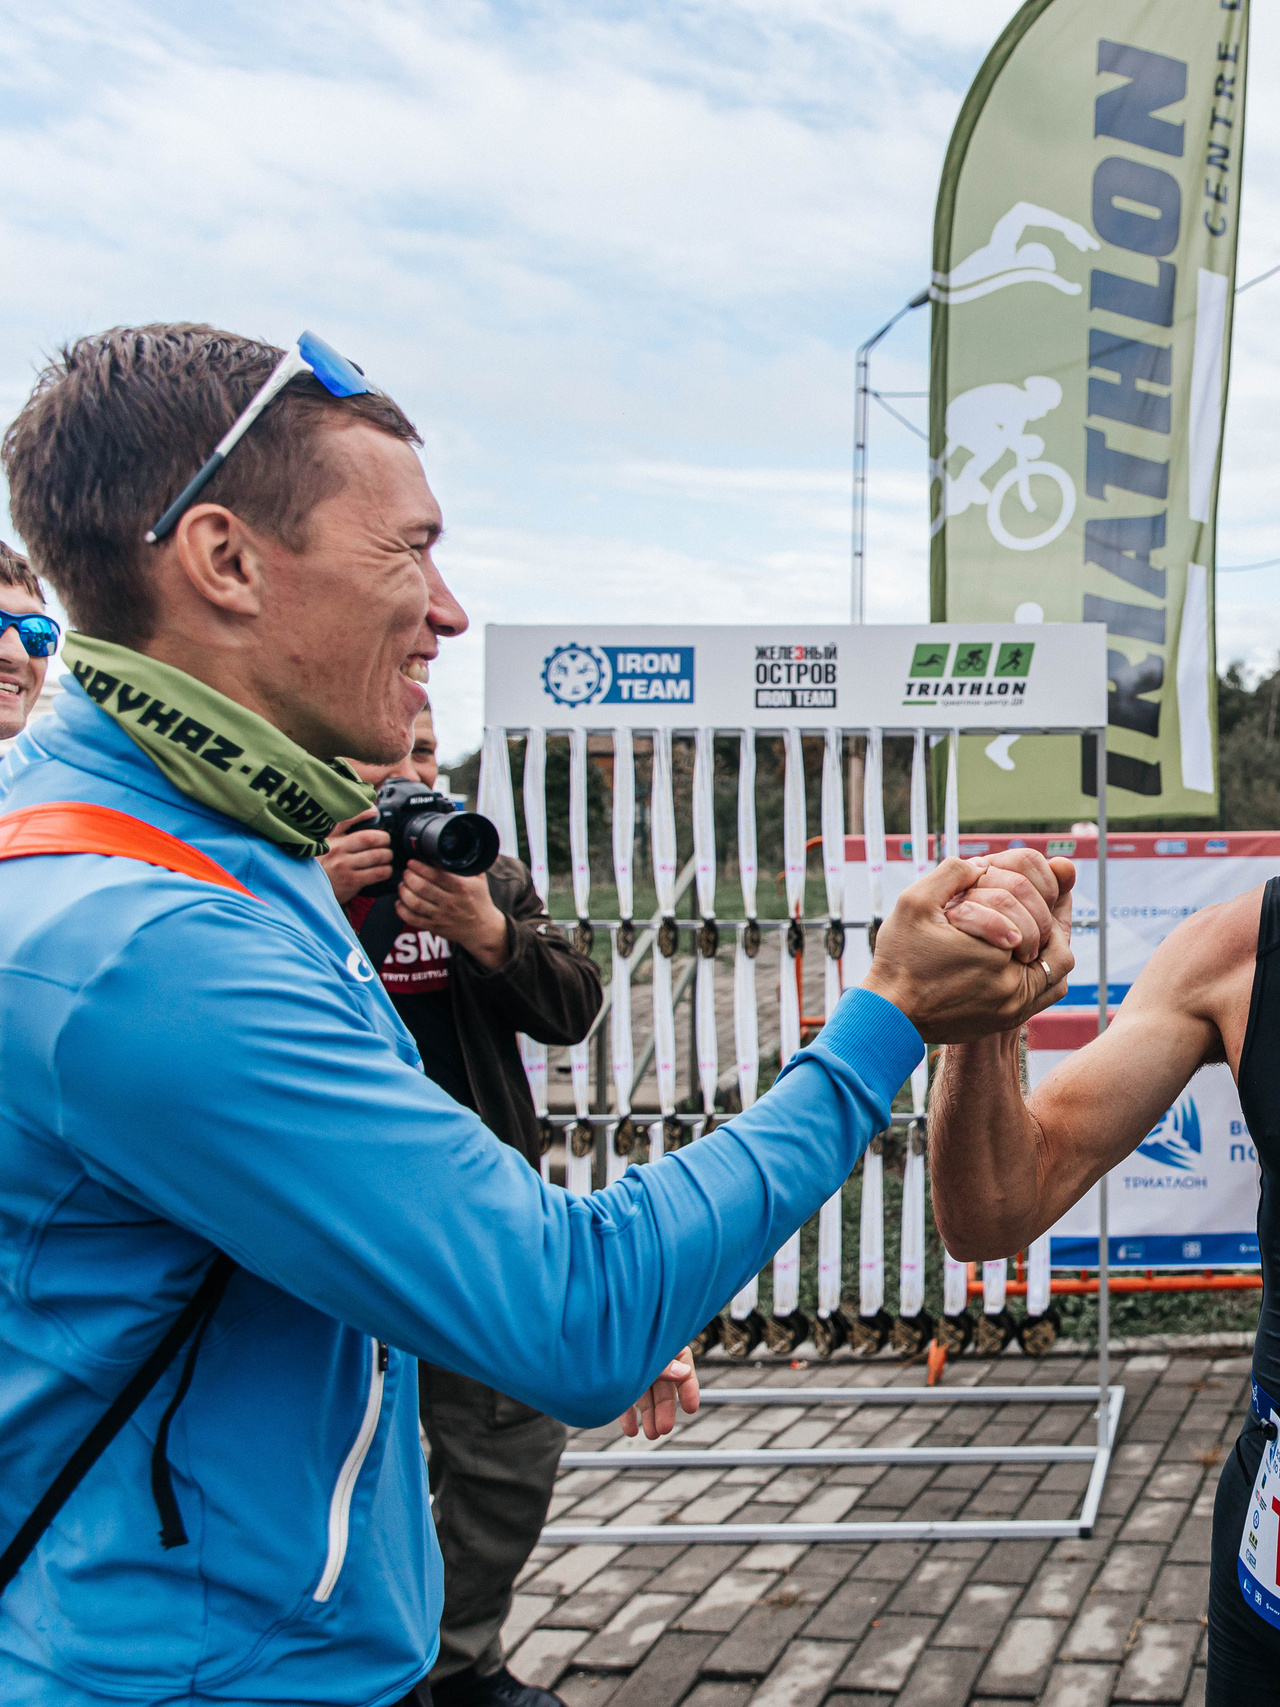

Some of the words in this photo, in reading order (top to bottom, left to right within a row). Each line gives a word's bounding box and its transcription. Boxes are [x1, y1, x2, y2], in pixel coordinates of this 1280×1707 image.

[1203, 41, 1239, 238] CENTRE
[755, 641, 837, 661] ЖЕЛЕЗНЫЙ
[616, 652, 682, 674] IRON
[755, 662, 837, 685] ОСТРОВ
[617, 679, 691, 700] TEAM
[757, 690, 793, 707] IRON
[795, 690, 835, 707] TEAM
[905, 682, 1027, 696] TRIATHLON
[383, 929, 453, 965] SM
[1122, 1175, 1209, 1190] ТРИАТЛОН
